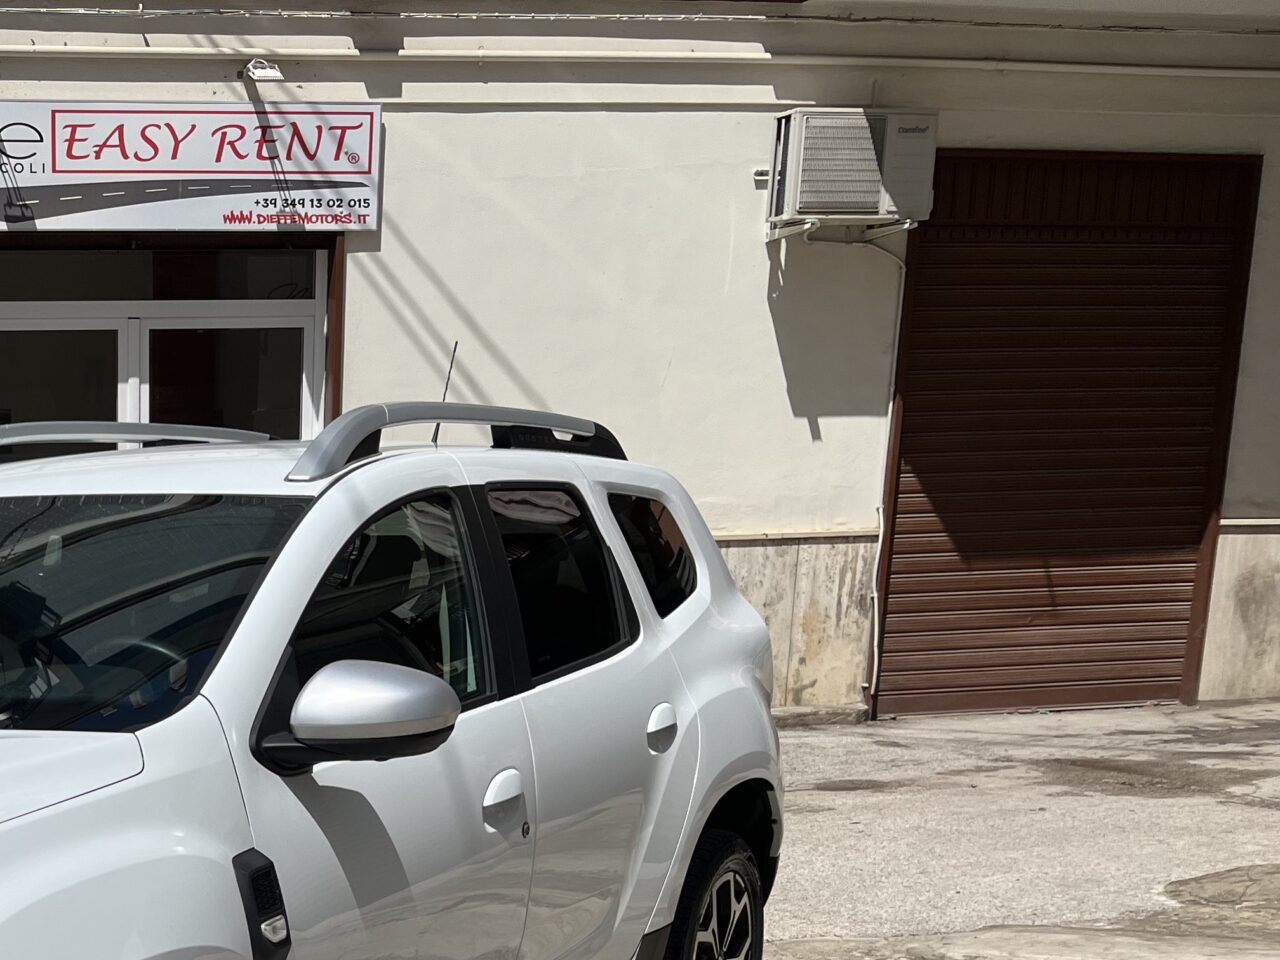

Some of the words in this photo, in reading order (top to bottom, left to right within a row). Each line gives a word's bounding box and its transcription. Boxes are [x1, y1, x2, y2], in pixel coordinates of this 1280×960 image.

[62, 122, 197, 162] EASY
[211, 122, 363, 163] RENT
[254, 198, 277, 208] +39
[281, 198, 305, 208] 349
[309, 198, 323, 208] 13
[327, 198, 344, 208] 02
[348, 198, 370, 208] 015
